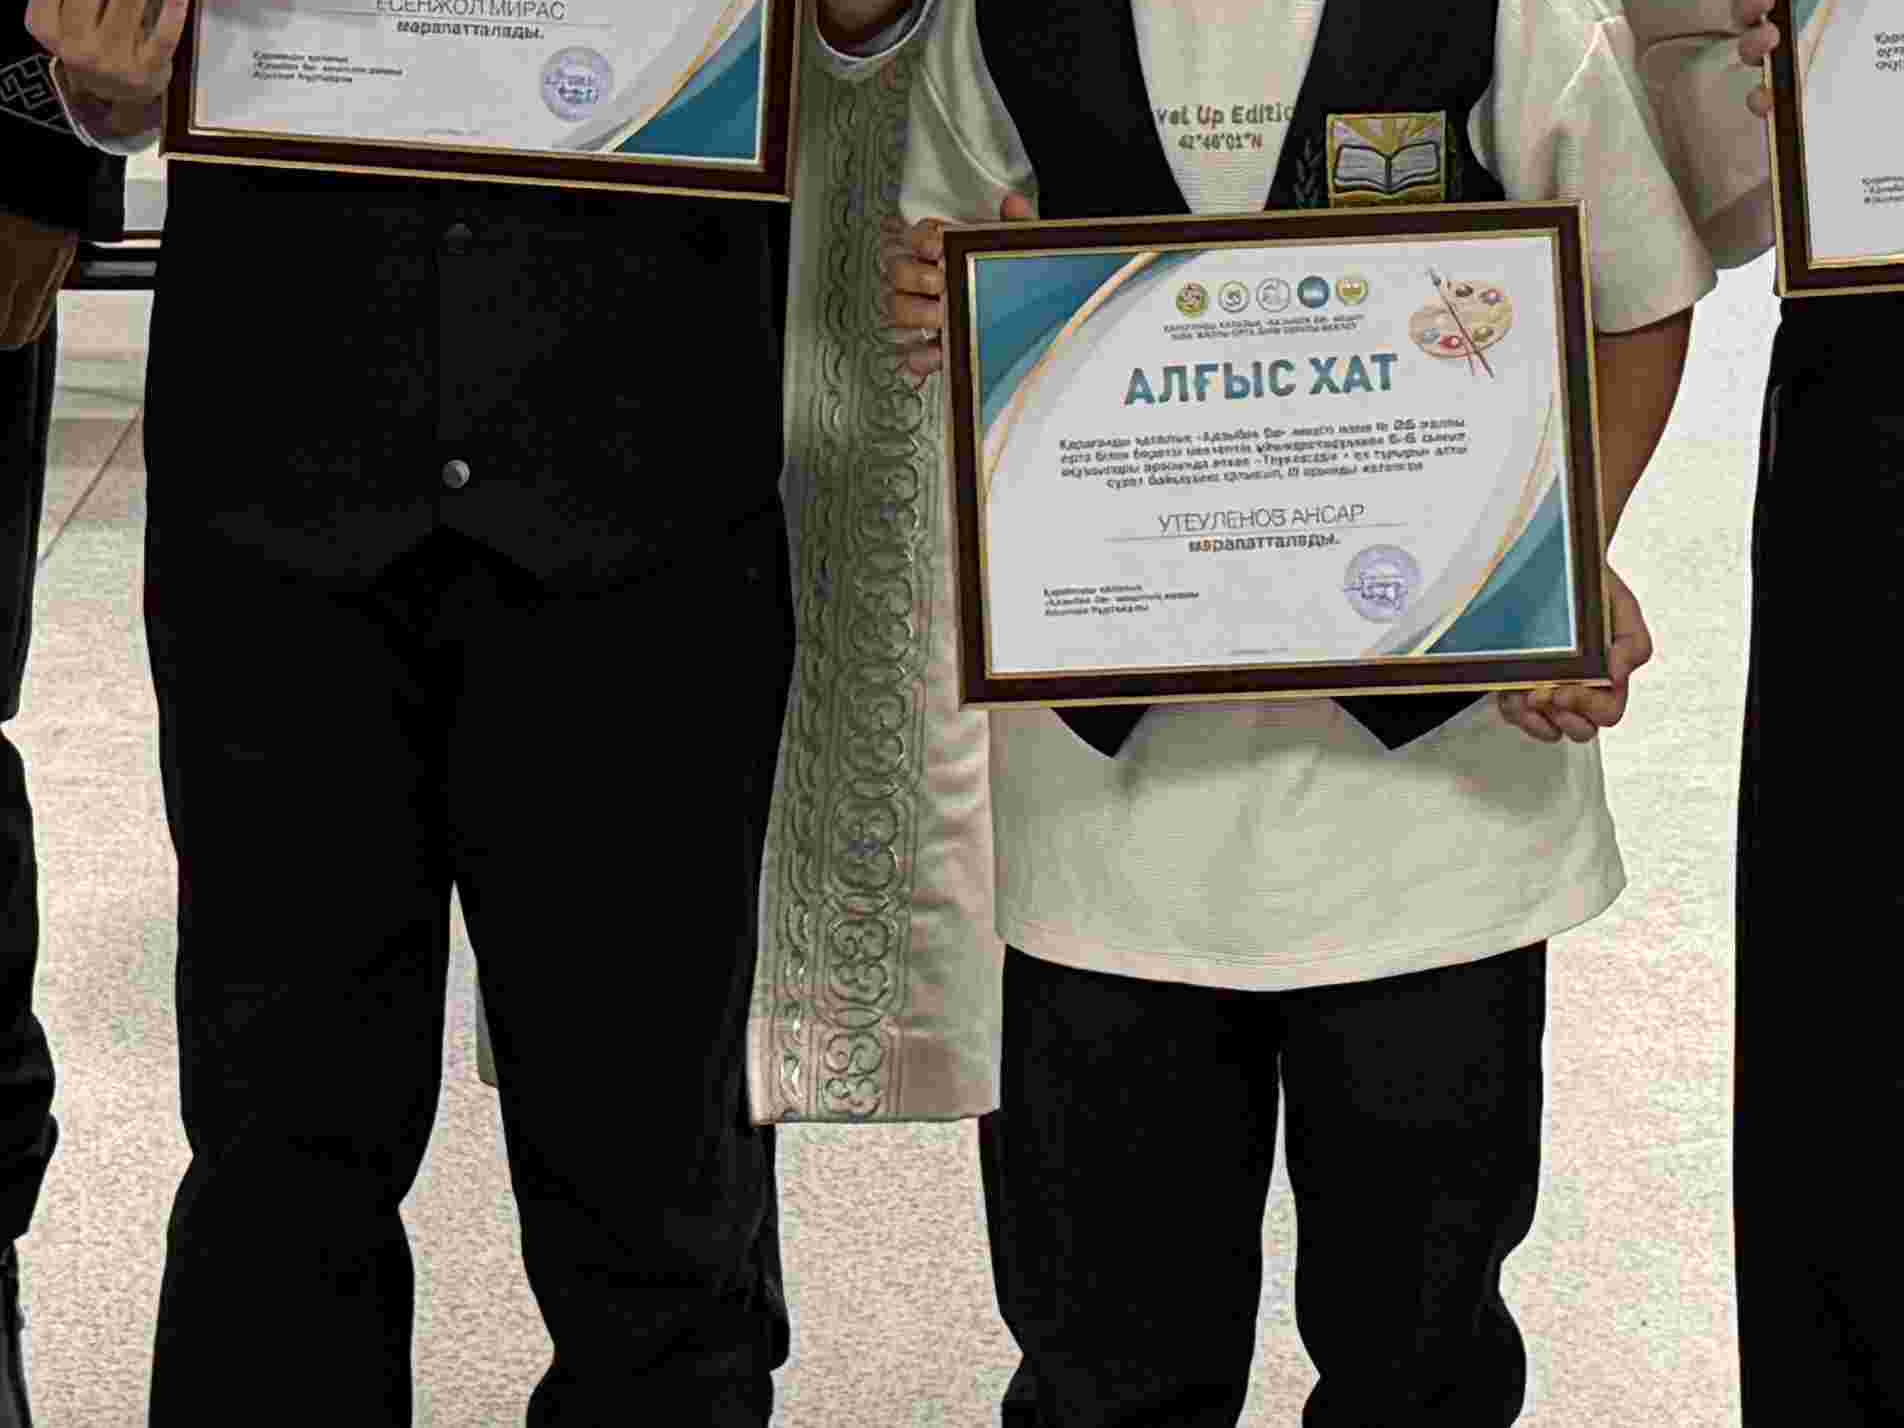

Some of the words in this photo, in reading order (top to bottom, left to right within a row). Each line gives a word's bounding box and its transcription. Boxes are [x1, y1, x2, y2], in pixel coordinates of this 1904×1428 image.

[1198, 104, 1224, 129] Up
[1232, 102, 1296, 125] Editio
[1124, 359, 1296, 405] АЛҒЫС
[1308, 353, 1398, 395] ХАТ
